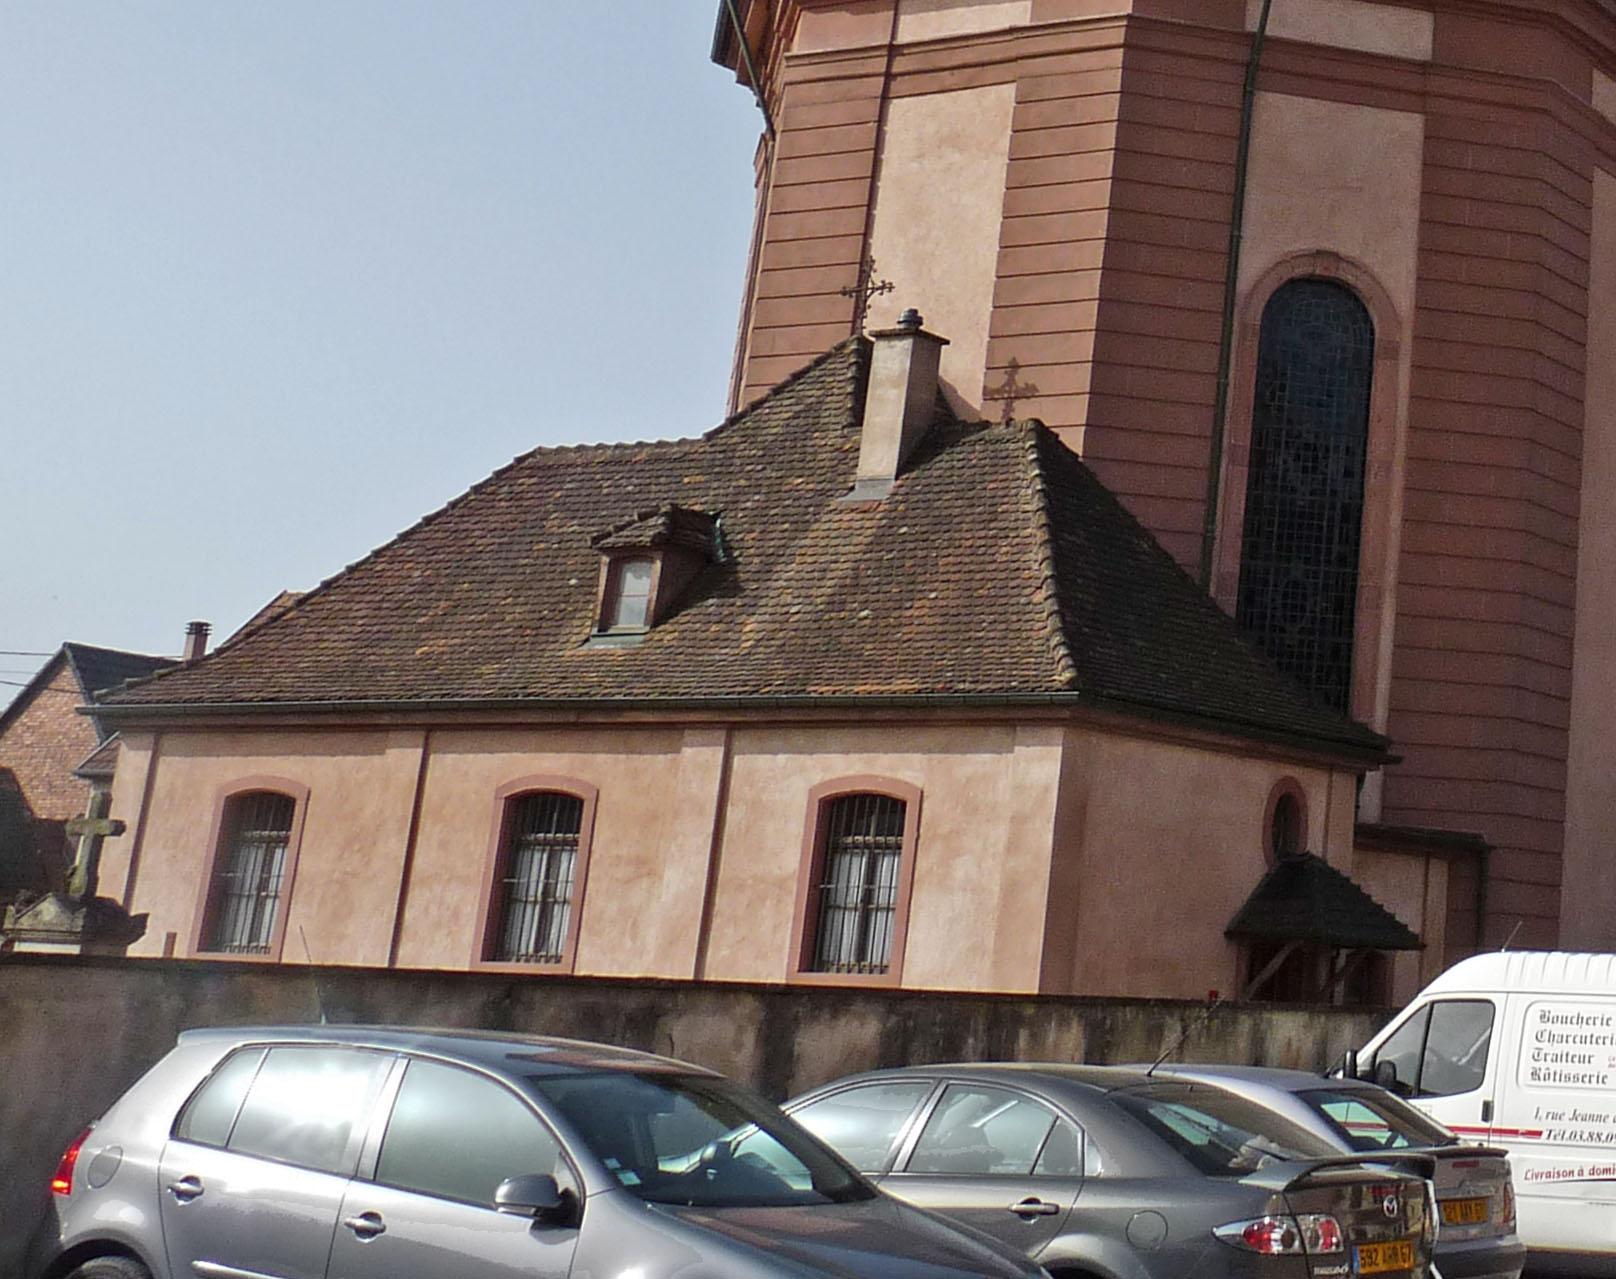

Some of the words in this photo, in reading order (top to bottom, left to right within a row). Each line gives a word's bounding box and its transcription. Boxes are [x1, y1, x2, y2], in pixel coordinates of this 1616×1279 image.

[1539, 1010, 1612, 1028] Boucherie
[1531, 1047, 1595, 1064] Traiteur
[1530, 1066, 1608, 1085] Rôtisserie
[1545, 1110, 1565, 1121] rue
[1568, 1108, 1610, 1124] Jeanne
[1524, 1168, 1575, 1181] Livraison
[1577, 1165, 1585, 1177] à
[1359, 1247, 1379, 1268] 592
